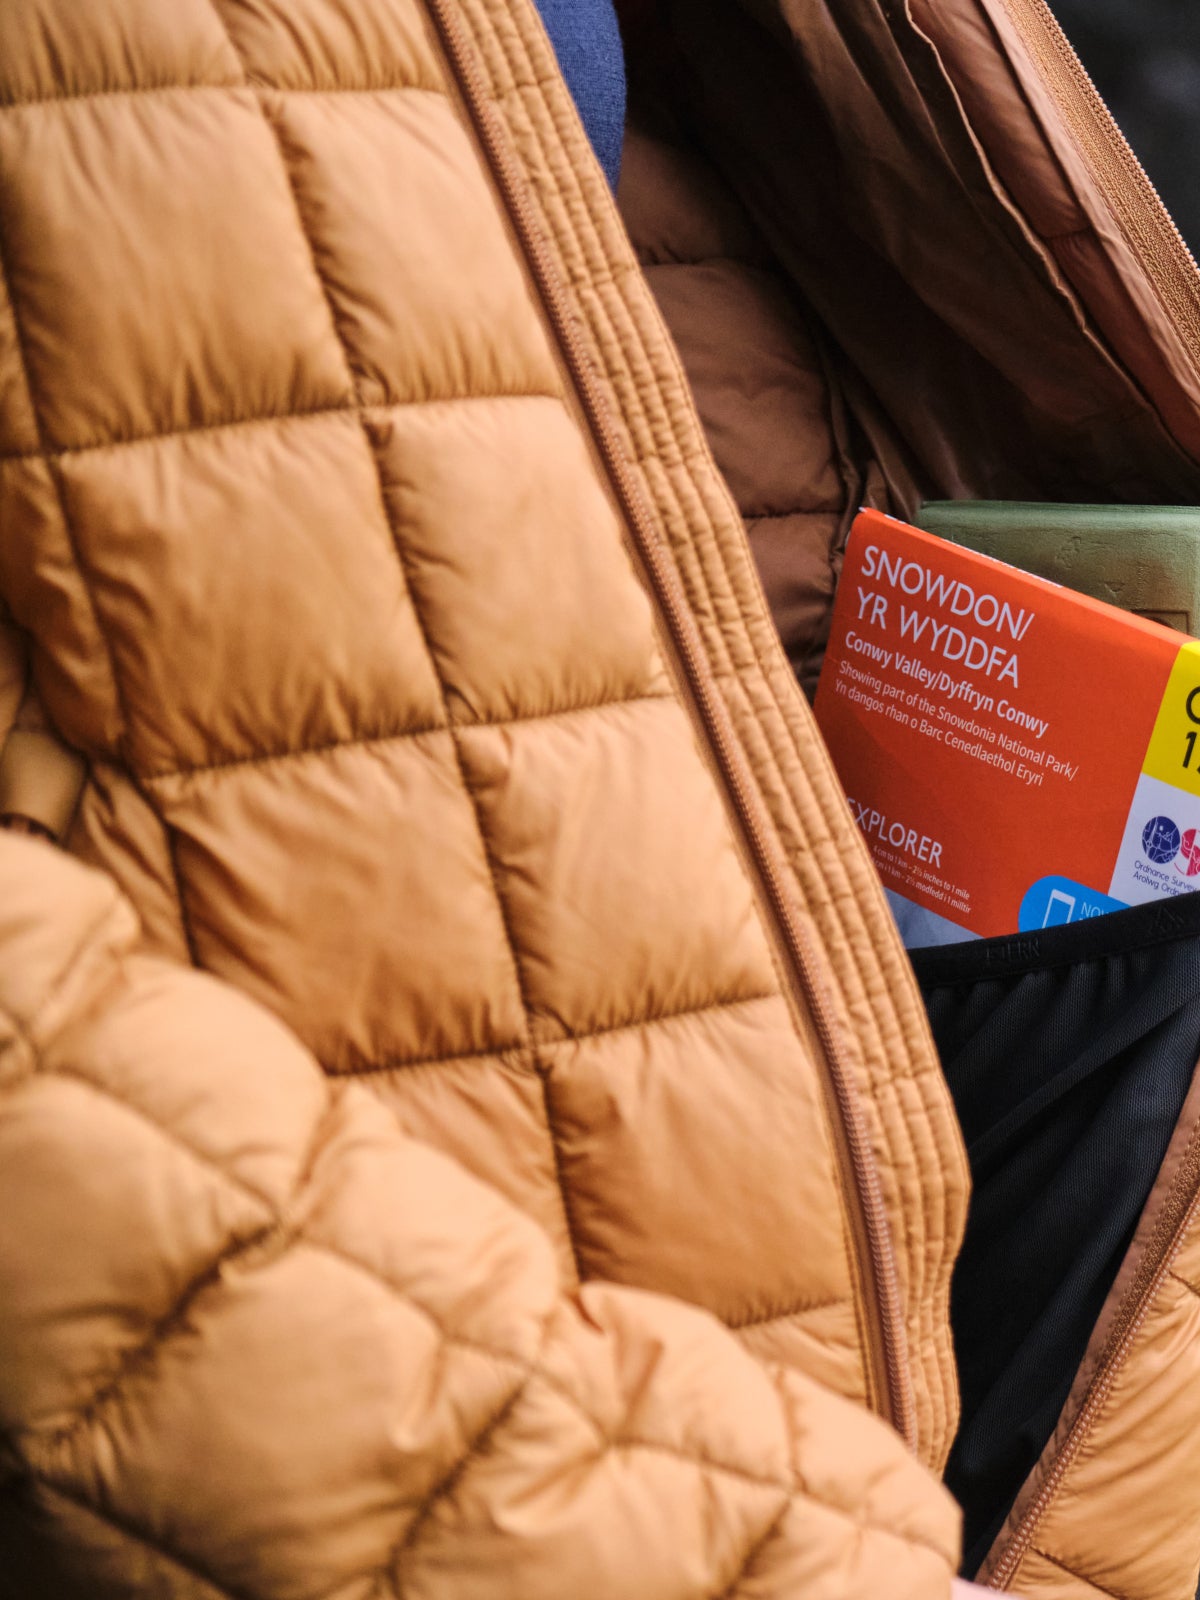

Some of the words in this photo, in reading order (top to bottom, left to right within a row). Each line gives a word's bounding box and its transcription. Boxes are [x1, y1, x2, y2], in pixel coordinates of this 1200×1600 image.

[857, 586, 887, 630] YR
[900, 604, 1018, 688] WYDDFA
[861, 545, 1035, 641] SNOWDON/
[835, 679, 847, 695] Yn
[848, 686, 884, 711] dangos
[885, 704, 909, 724] rhan
[910, 718, 918, 729] o
[919, 719, 943, 741] Barc
[944, 731, 1016, 774] Cenedlaethol
[1016, 763, 1044, 786] Eryri
[839, 660, 882, 694] Showing
[882, 683, 905, 703] part
[905, 693, 919, 707] of
[918, 698, 936, 716] the
[937, 706, 996, 743] Snowdonia
[997, 733, 1045, 766] National
[1045, 755, 1079, 781] Park/
[845, 631, 893, 669] Conwy
[895, 652, 994, 711] Valley/Dyffryn
[997, 699, 1049, 739] Conwy
[923, 870, 943, 887] inches
[944, 881, 951, 891] to
[955, 888, 970, 900] mile
[1133, 871, 1160, 889] Arolwg
[1161, 883, 1180, 895] Ordn
[1134, 860, 1169, 881] Ordnance
[1171, 876, 1197, 892] Survey
